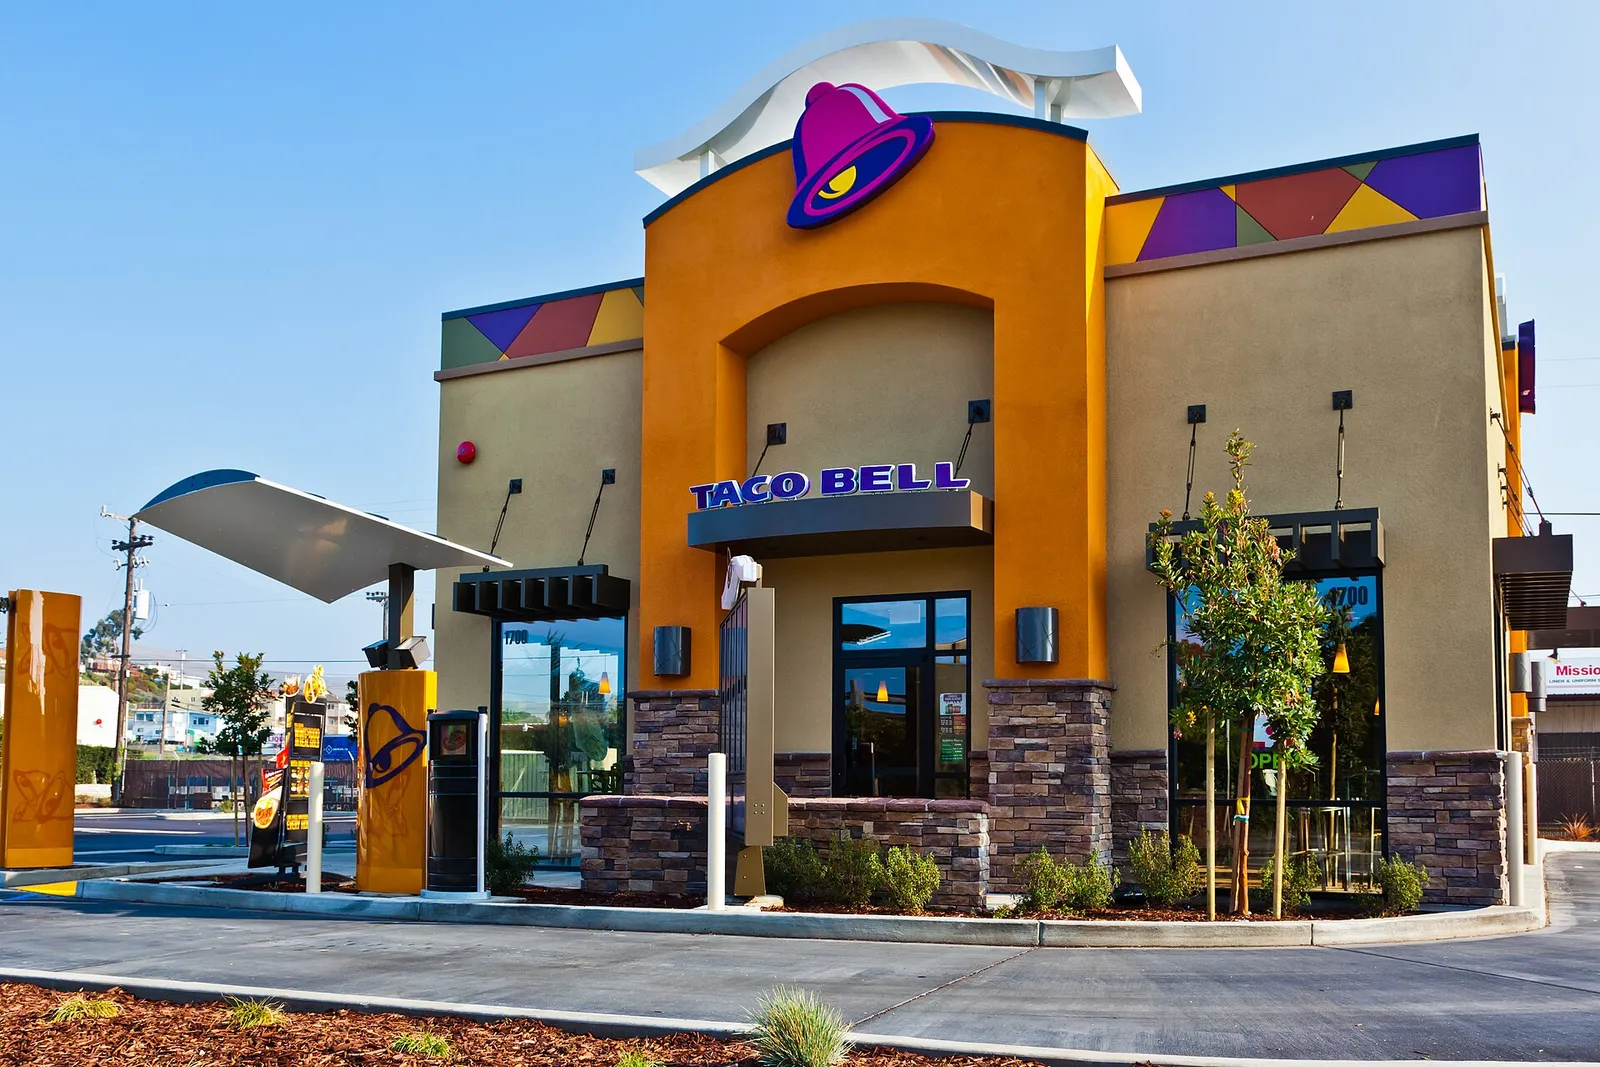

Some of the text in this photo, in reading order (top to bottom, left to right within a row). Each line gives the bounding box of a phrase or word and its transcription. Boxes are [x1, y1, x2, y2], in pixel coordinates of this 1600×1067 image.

[689, 461, 971, 510] TACO BELL
[1329, 585, 1368, 606] 1700
[504, 629, 529, 645] 1700
[1251, 752, 1279, 769] OPE
